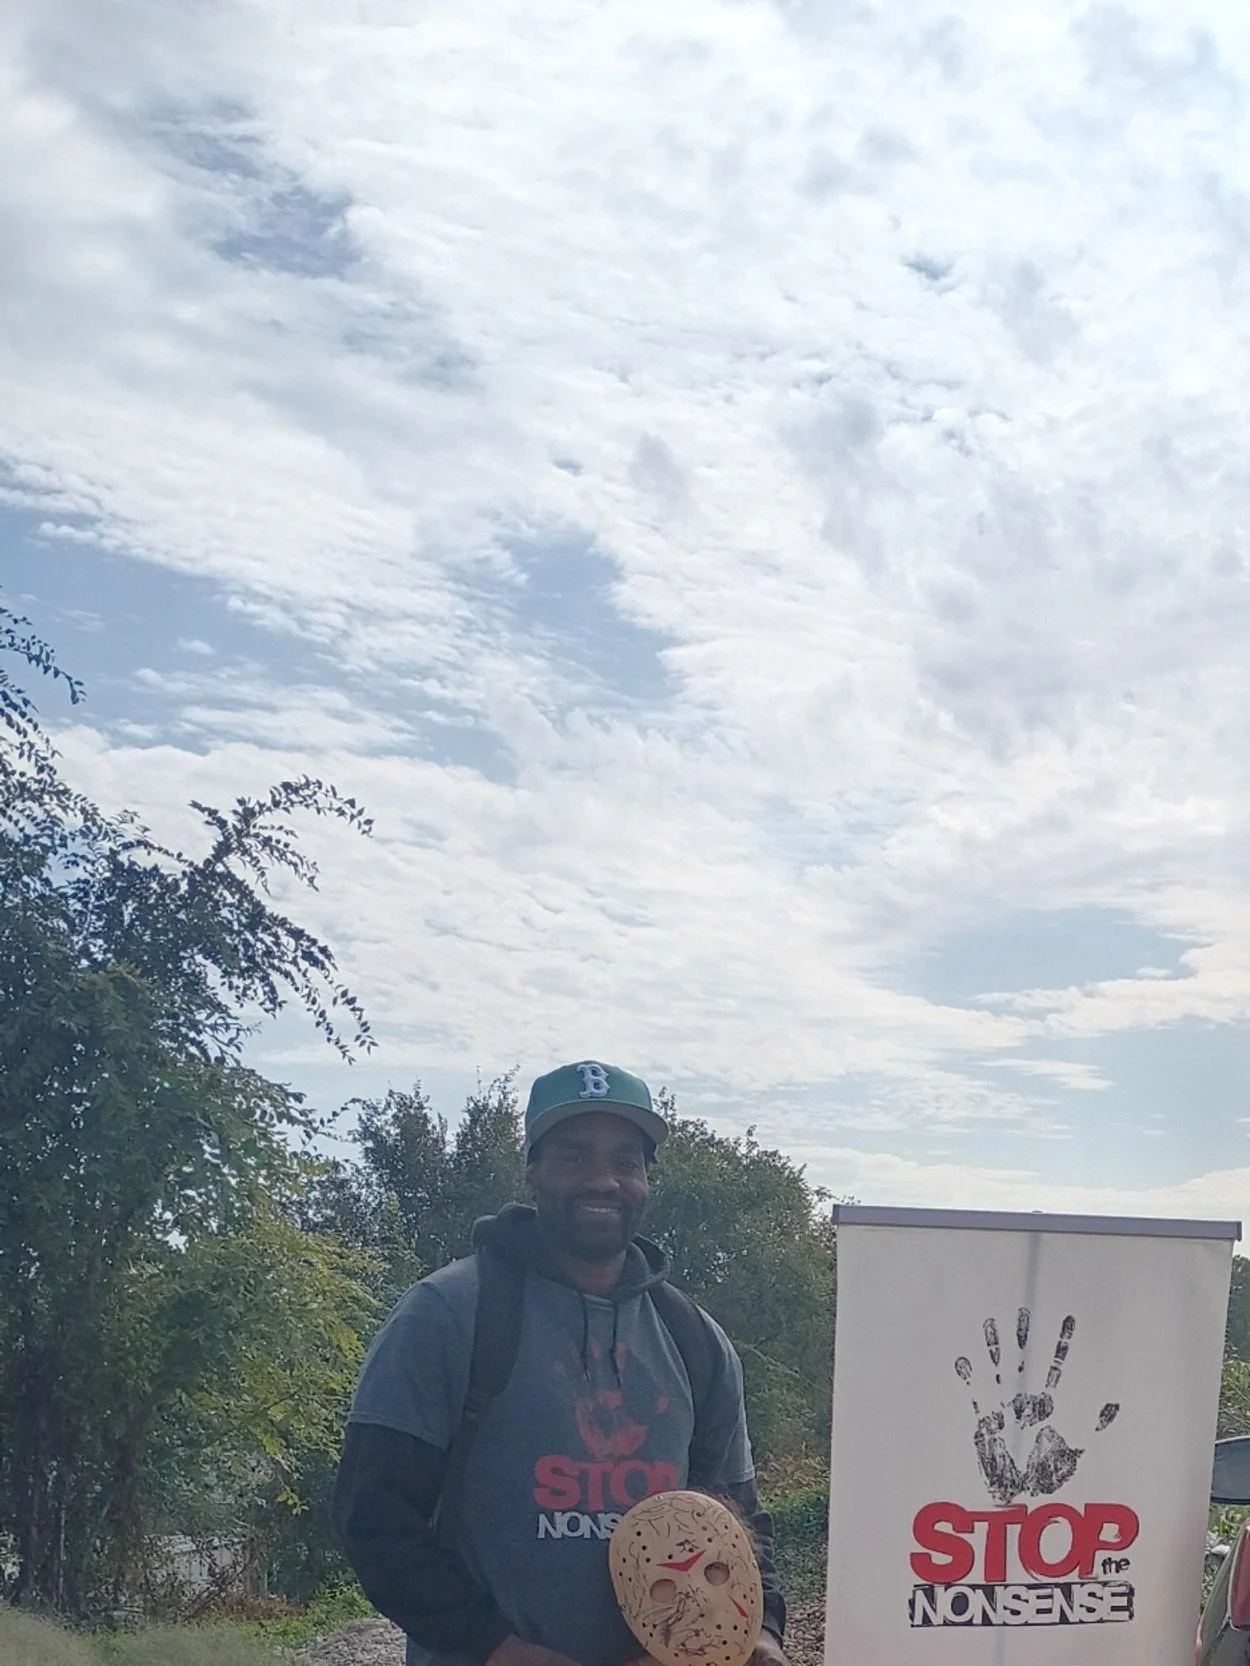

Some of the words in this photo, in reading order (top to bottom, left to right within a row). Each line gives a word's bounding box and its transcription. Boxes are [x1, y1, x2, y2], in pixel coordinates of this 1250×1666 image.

[576, 1063, 609, 1098] B
[537, 1511, 624, 1541] NONS
[910, 1501, 1140, 1584] STOP
[1101, 1556, 1131, 1576] the
[912, 1582, 1132, 1625] NONSENSE
